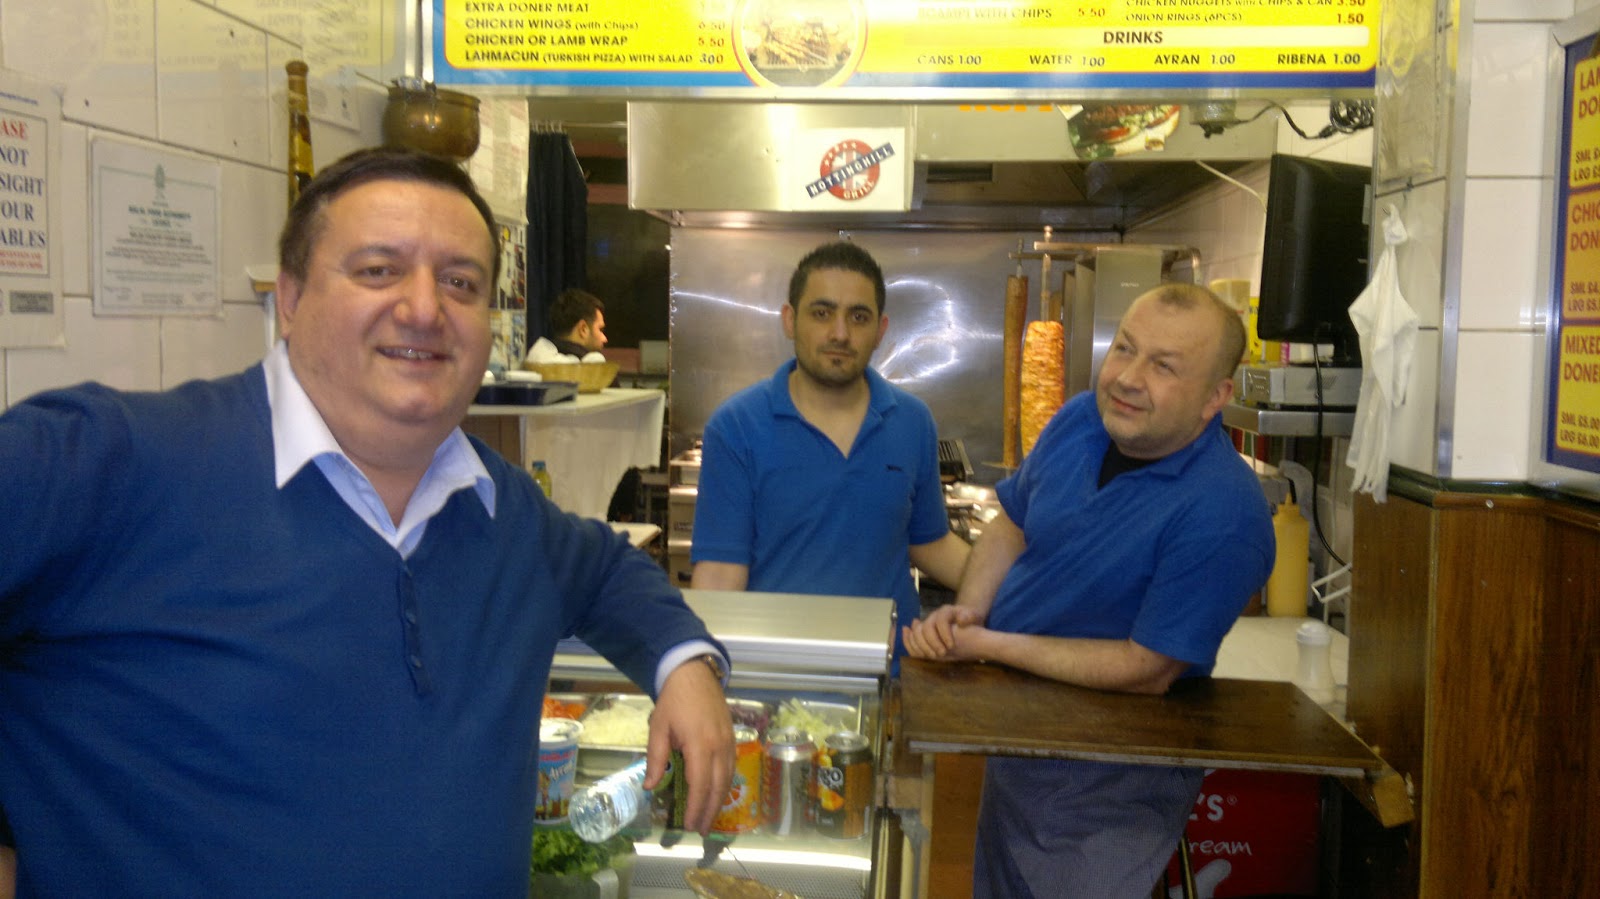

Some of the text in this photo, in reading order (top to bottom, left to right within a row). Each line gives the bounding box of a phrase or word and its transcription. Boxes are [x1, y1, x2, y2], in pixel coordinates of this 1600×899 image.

[465, 3, 589, 13] EXTRA DONER MEAT
[1011, 8, 1052, 18] CHIPS
[465, 19, 524, 29] CHICKEN
[528, 19, 572, 29] WINGS
[1126, 13, 1164, 22] ONION
[1167, 13, 1201, 22] RINGS
[1336, 13, 1364, 24] 1.50
[465, 35, 524, 46] CHICKEN
[528, 35, 547, 46] OR
[551, 35, 586, 46] LAMB
[590, 35, 628, 46] WRAP
[1103, 31, 1163, 44] DRINKS
[465, 50, 539, 62] LAHMACUN
[543, 52, 590, 63] (TURKISH
[593, 53, 625, 64] PIZZA)
[629, 54, 655, 63] WITH
[658, 54, 693, 63] SALAD
[917, 54, 954, 65] CANS
[1029, 54, 1073, 66] WATER
[1154, 54, 1236, 65] AYRAN 1.00
[1277, 53, 1361, 65] RIBENA 1.00
[808, 146, 892, 197] NOTTINGHILL
[843, 180, 876, 200] GRILL
[1563, 361, 1600, 384] DONE
